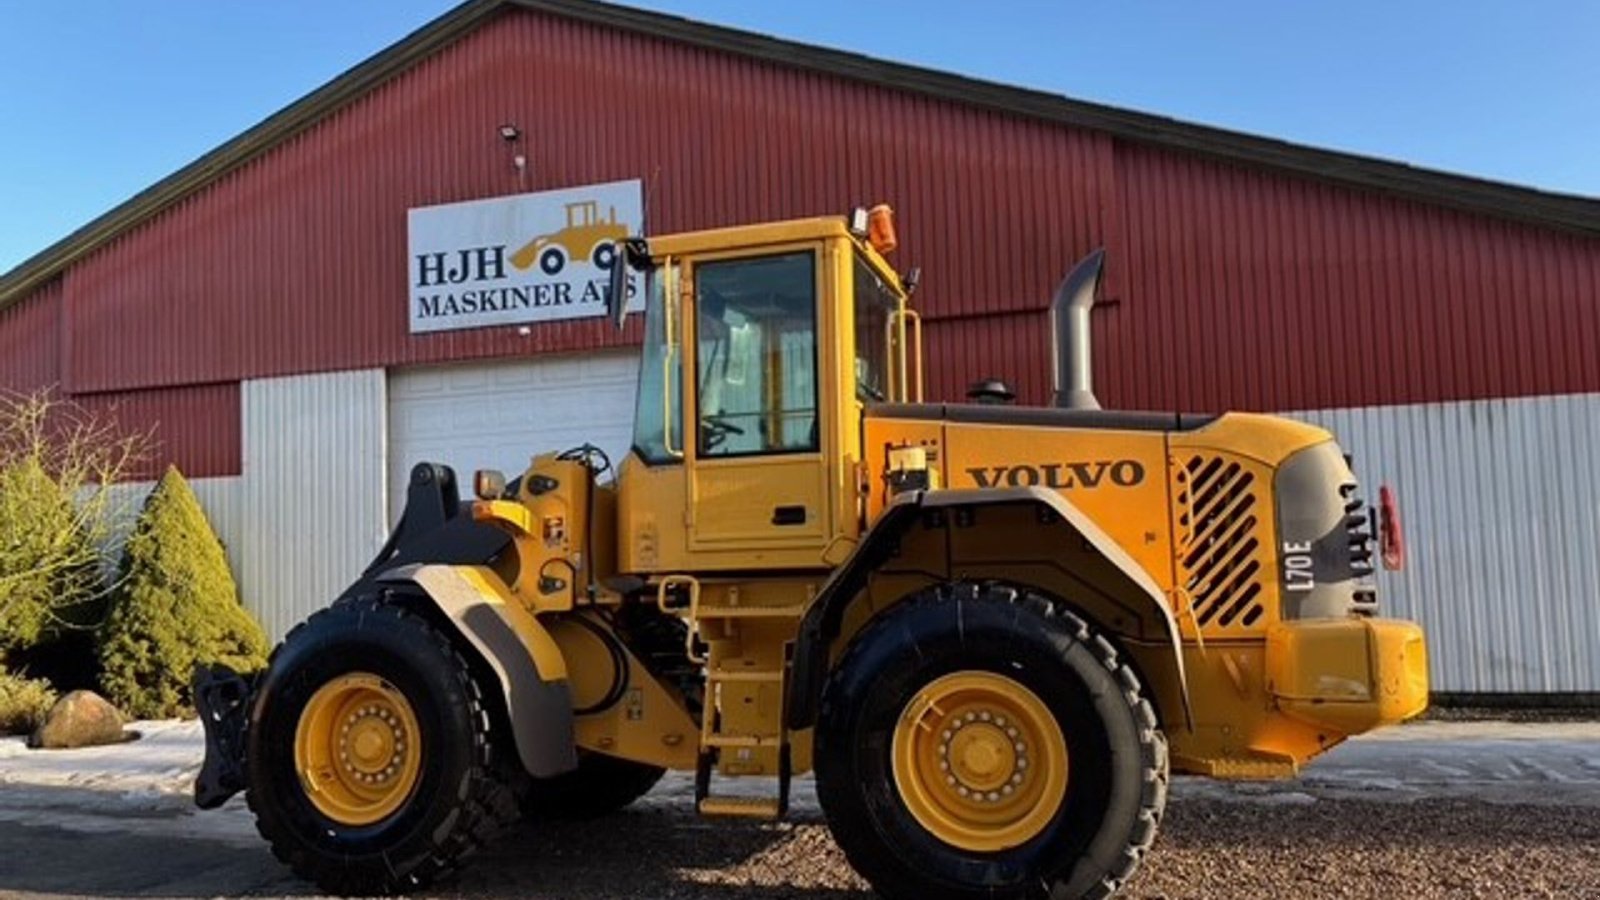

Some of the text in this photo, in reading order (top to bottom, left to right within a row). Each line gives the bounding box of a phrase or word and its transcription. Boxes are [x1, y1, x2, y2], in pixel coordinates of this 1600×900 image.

[416, 245, 507, 288] HJH
[417, 281, 573, 319] MASKINER
[966, 459, 1145, 489] VOLVO
